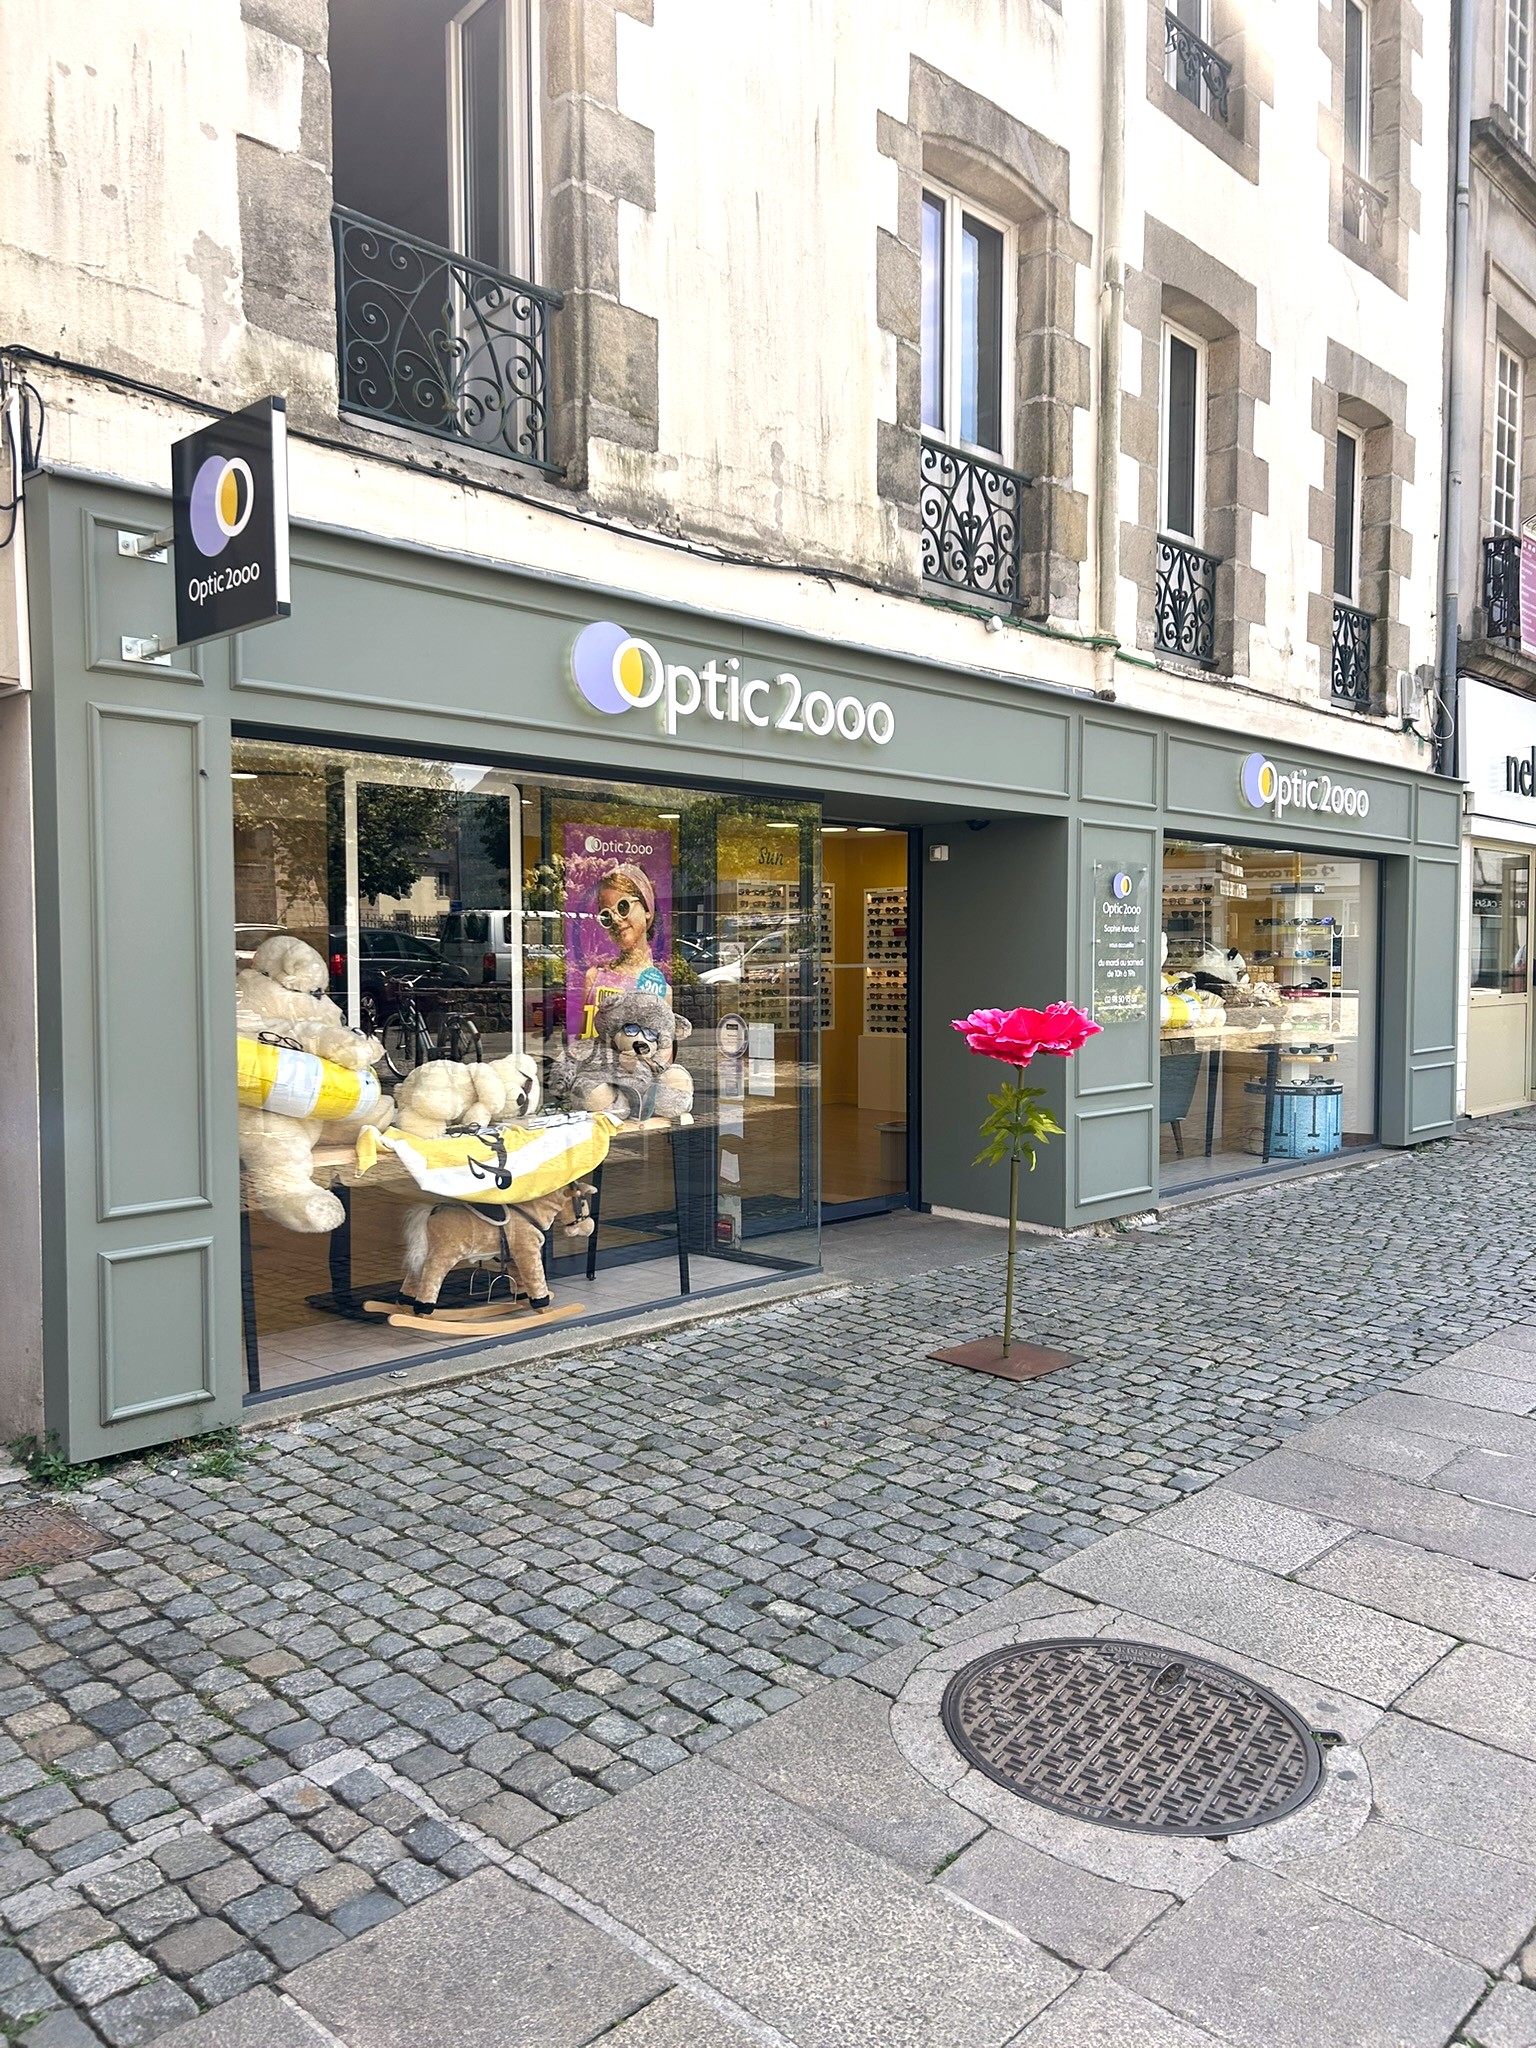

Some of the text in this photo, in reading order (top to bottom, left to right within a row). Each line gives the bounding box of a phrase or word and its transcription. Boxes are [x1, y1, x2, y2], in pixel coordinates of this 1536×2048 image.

[189, 562, 260, 606] Optic 2000
[612, 637, 895, 745] Optic 2000
[1258, 761, 1369, 818] Optic 2000
[591, 838, 653, 856] Optic 2000
[758, 847, 784, 866] Sun
[1102, 902, 1141, 917] Optic 2000
[1127, 958, 1144, 966] samedi
